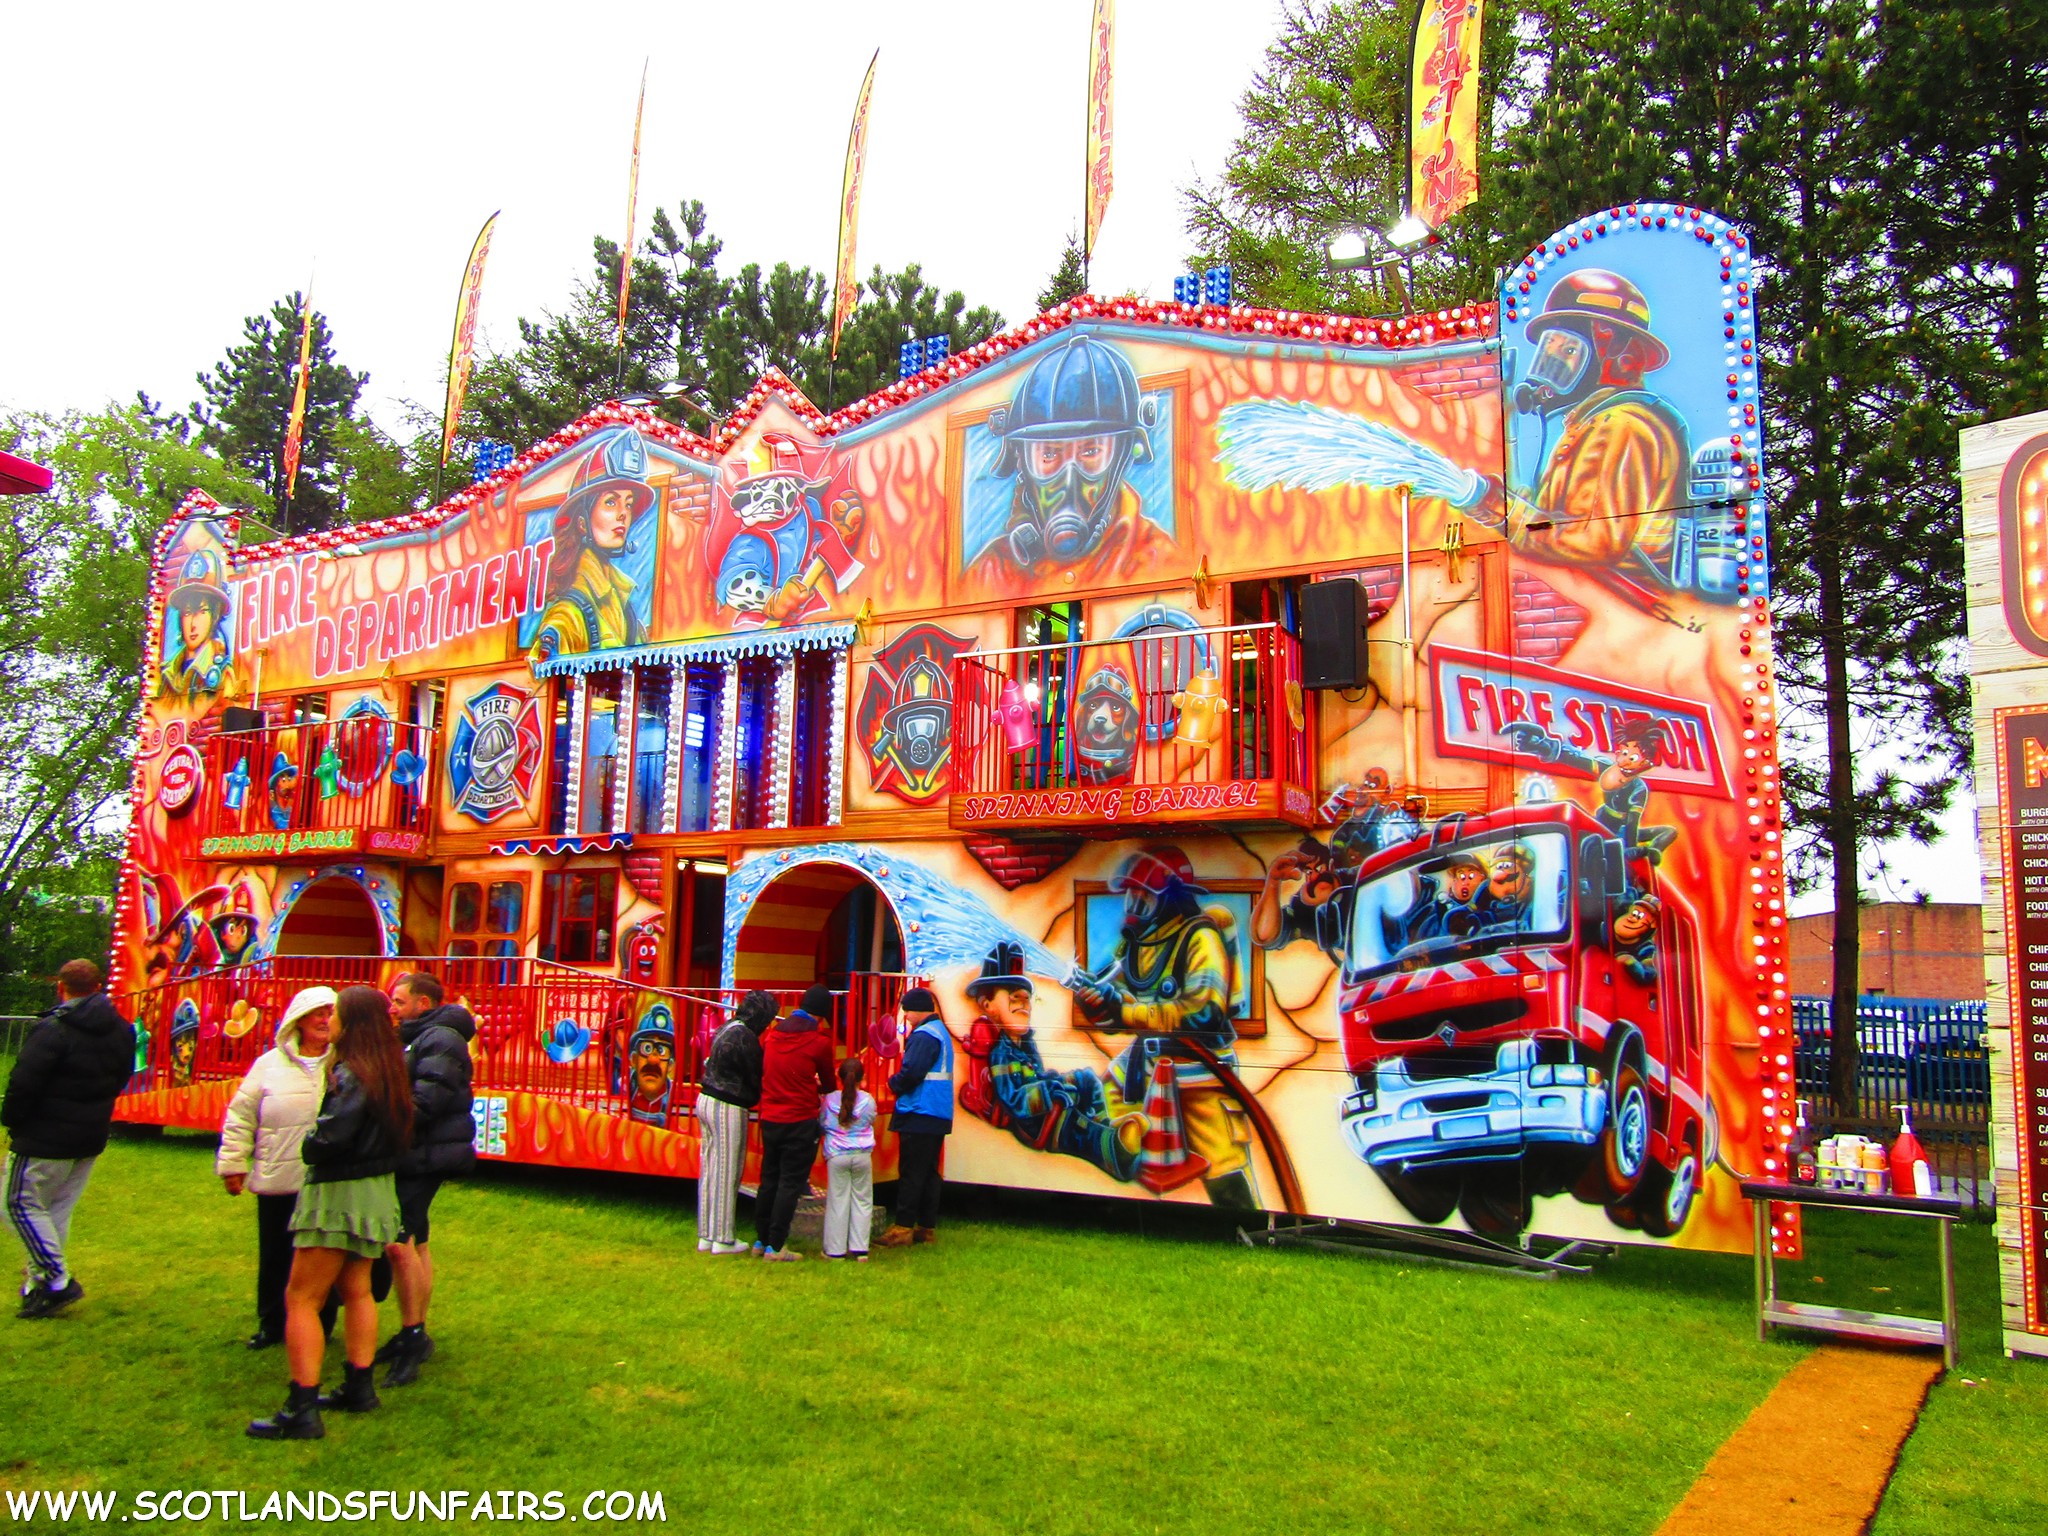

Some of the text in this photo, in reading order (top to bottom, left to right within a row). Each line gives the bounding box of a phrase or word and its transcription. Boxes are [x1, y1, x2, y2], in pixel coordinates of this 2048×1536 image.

[239, 537, 556, 679] FIRE DEPARTMENT
[480, 699, 510, 718] FIRE
[1457, 674, 1563, 740] FIRE
[164, 754, 194, 776] CENTRAL
[171, 772, 187, 784] FIRE
[162, 780, 192, 804] STATION
[467, 788, 514, 804] DEPARTMENT
[964, 782, 1259, 820] SPINNING BARREL
[201, 829, 354, 855] SPINNING BARREL
[372, 832, 424, 853] CRAZY
[2024, 876, 2043, 885] HOT
